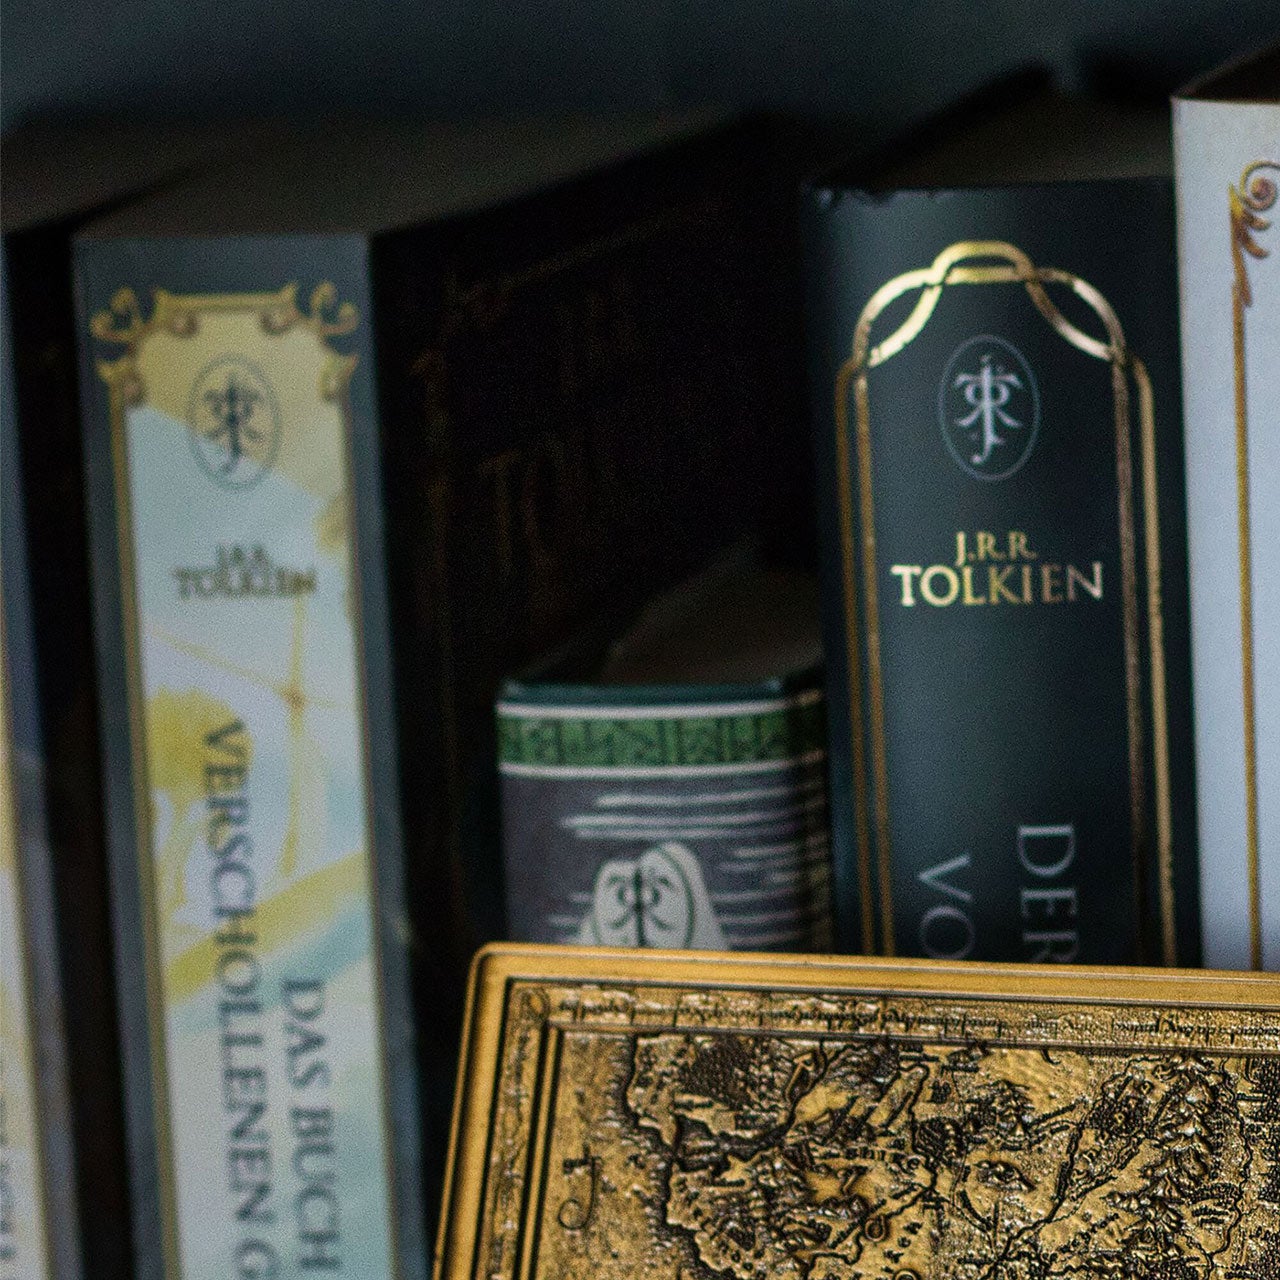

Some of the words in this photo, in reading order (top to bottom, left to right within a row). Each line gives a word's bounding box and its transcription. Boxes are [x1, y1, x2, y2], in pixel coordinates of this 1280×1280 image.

[891, 561, 1102, 607] TOLKIEN
[204, 719, 276, 1224] VERSCHOLLENEN
[283, 977, 330, 1088] DAS
[290, 1106, 341, 1272] BUCH
